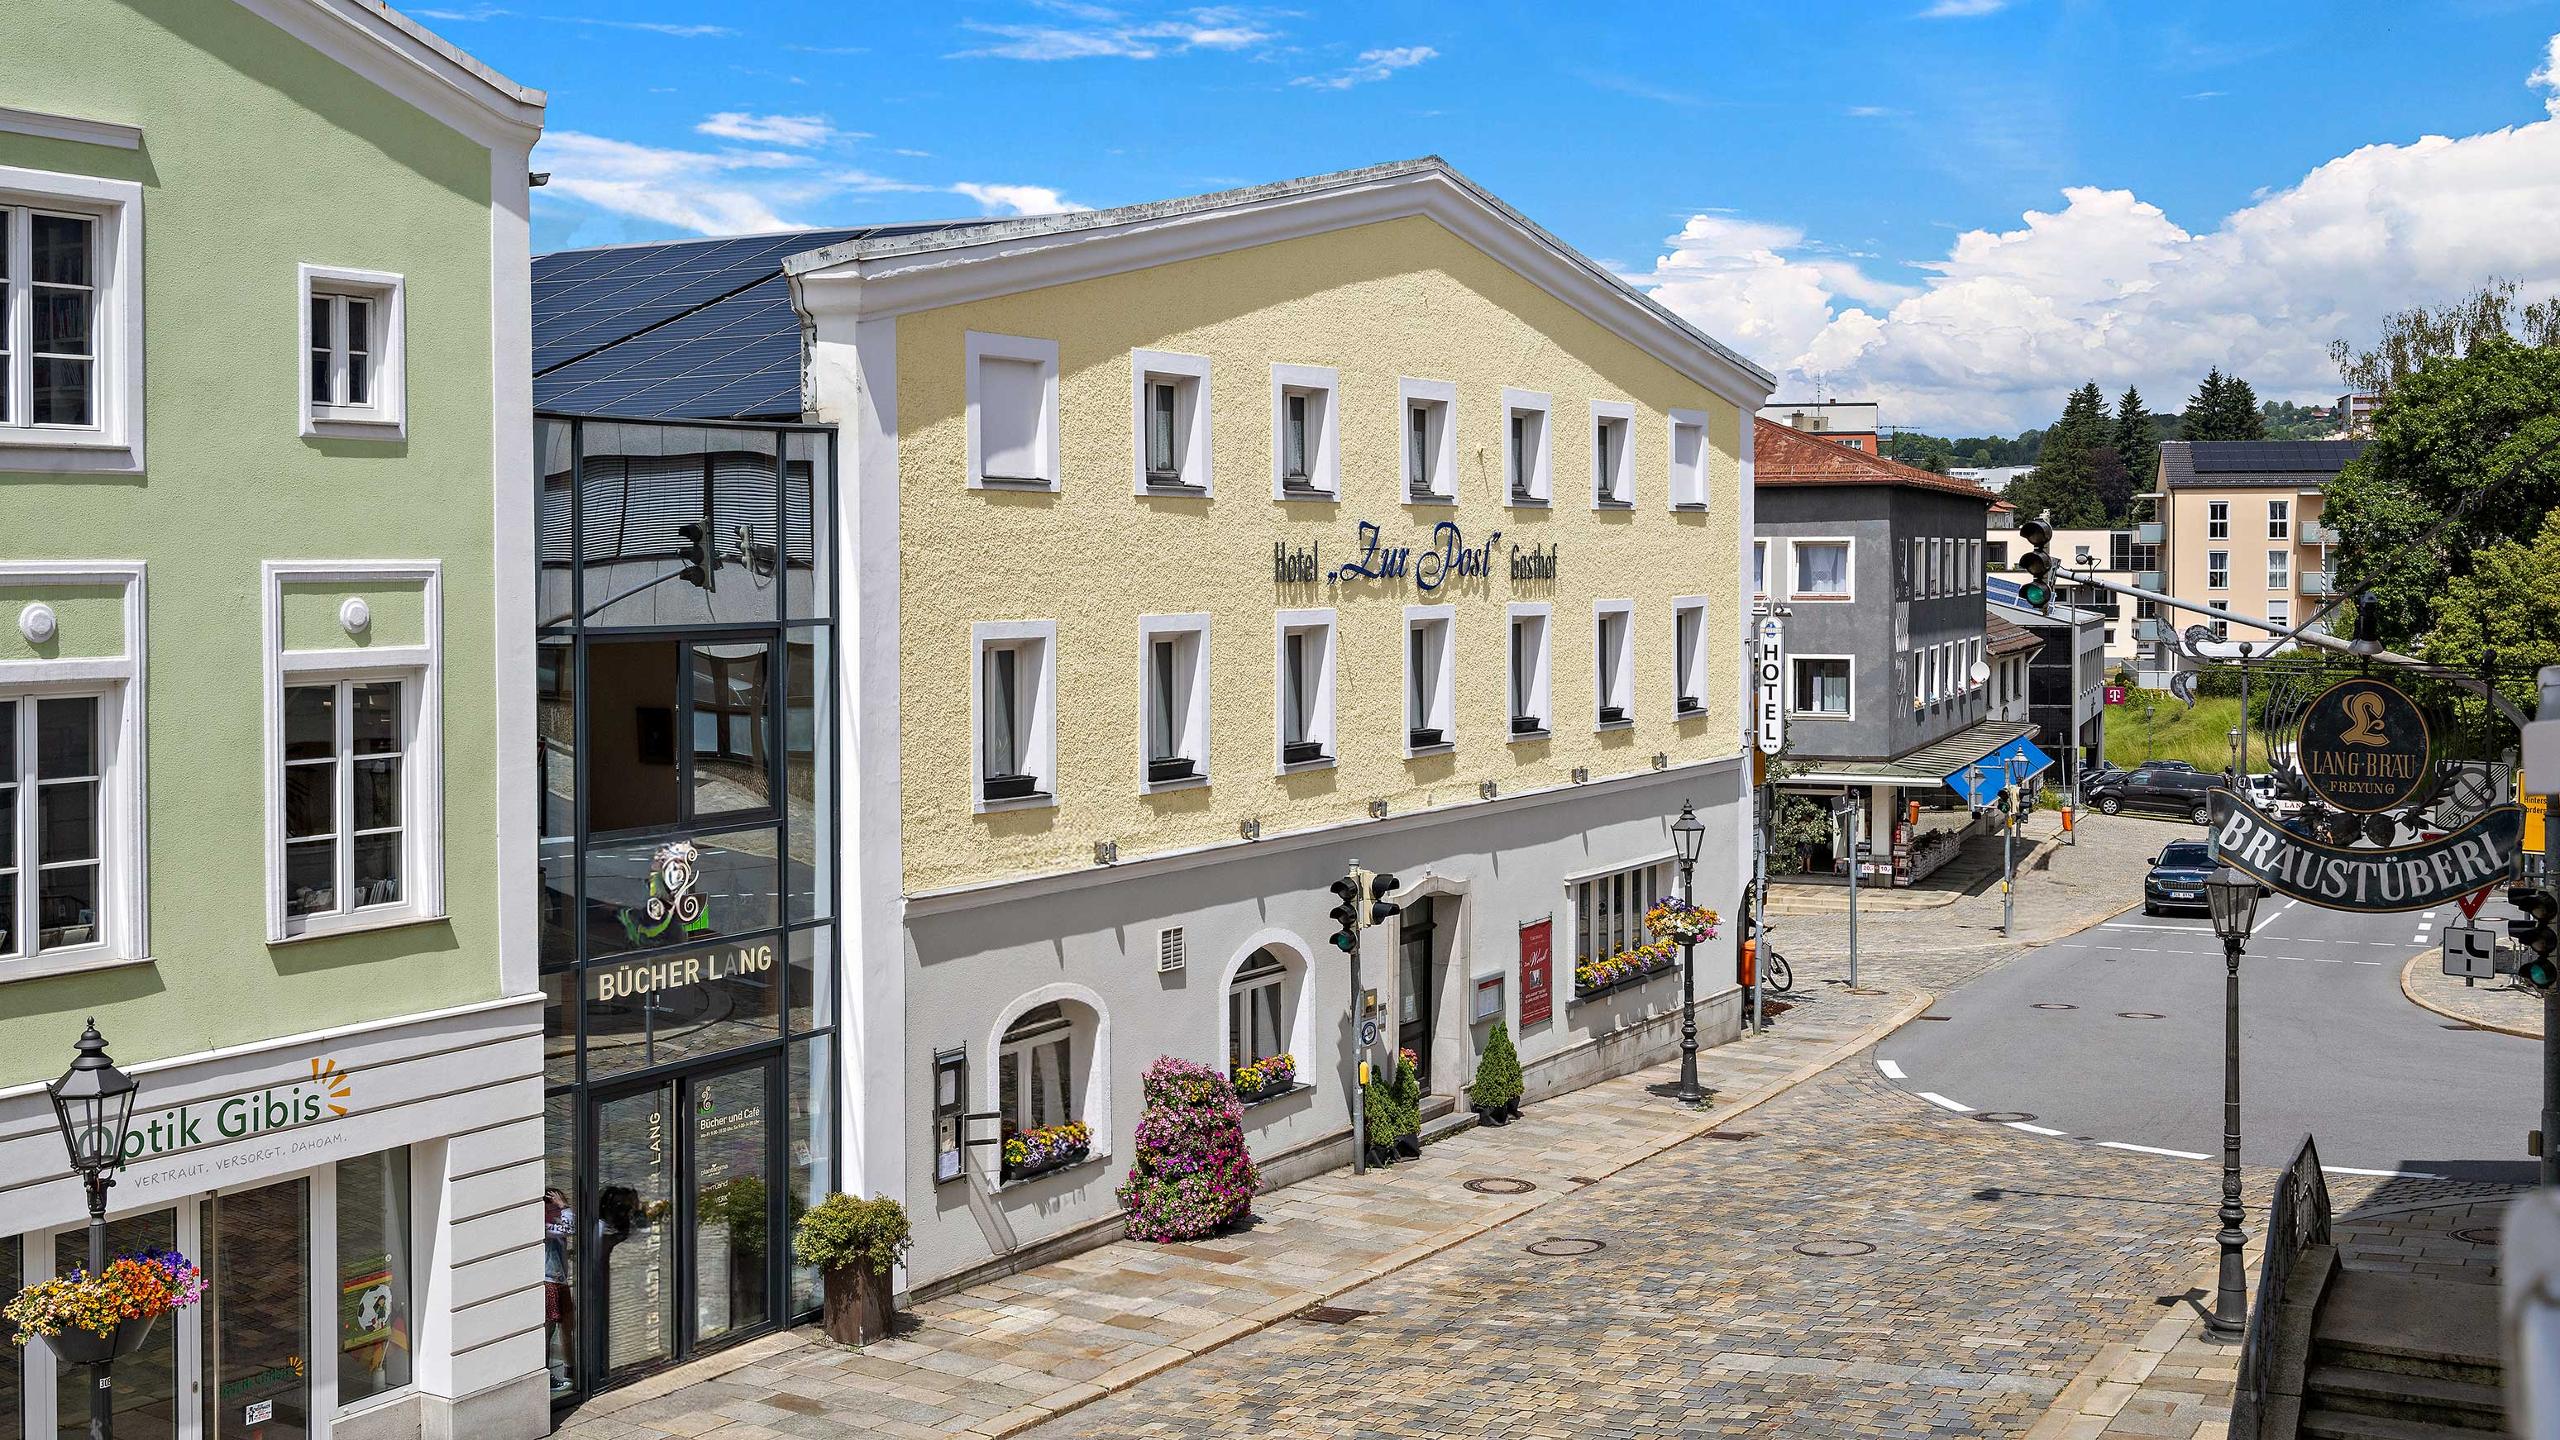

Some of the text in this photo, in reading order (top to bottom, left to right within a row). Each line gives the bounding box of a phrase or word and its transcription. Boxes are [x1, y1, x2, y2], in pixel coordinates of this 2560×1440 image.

[1274, 540, 1318, 583] Hotel
[1511, 543, 1558, 580] Gasthof
[1762, 644, 1779, 740] HOTEL
[2110, 690, 2121, 702] T
[2329, 780, 2395, 795] FREYUNG
[2524, 796, 2547, 804] Hinters
[2219, 810, 2511, 903] BRÄUSTÜBERL
[599, 945, 772, 1001] BÜCHER LANG
[78, 1087, 321, 1172] Optik Gibis
[649, 1111, 661, 1165] LANG
[700, 1115, 727, 1130] Bücher
[728, 1110, 742, 1122] und
[744, 1105, 760, 1118] Café
[134, 1133, 348, 1188] VERTRAUT. VERSORGT. DAHOAM.
